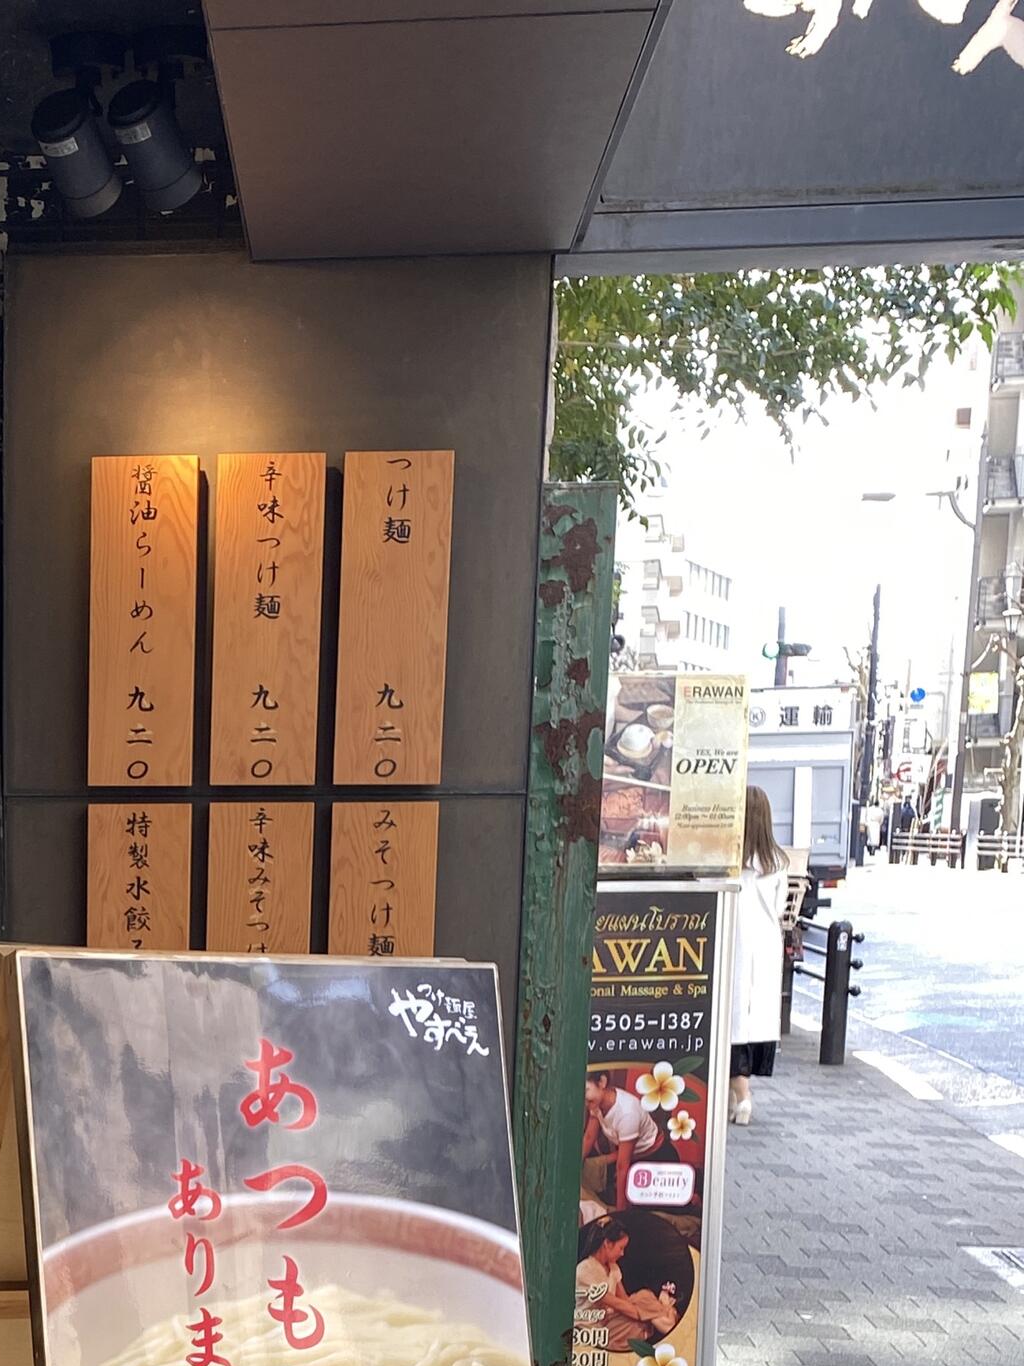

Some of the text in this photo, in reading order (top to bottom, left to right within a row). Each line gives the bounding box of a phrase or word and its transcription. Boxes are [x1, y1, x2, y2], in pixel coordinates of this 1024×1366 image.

[125, 463, 158, 780] 醤油らーめん 九二〇
[250, 461, 284, 780] 辛味つけ麺 九二〇
[373, 456, 412, 778] つけ麺 九二〇
[684, 686, 744, 698] ERAWAN
[779, 706, 833, 727] 運輸
[676, 758, 737, 775] OPEN
[367, 809, 397, 957] みそつけ麺
[620, 984, 669, 998] Massage
[673, 983, 683, 995] &
[687, 983, 707, 998] Spa
[388, 988, 490, 1056] やすべえ
[591, 1012, 704, 1031] 3505-1387
